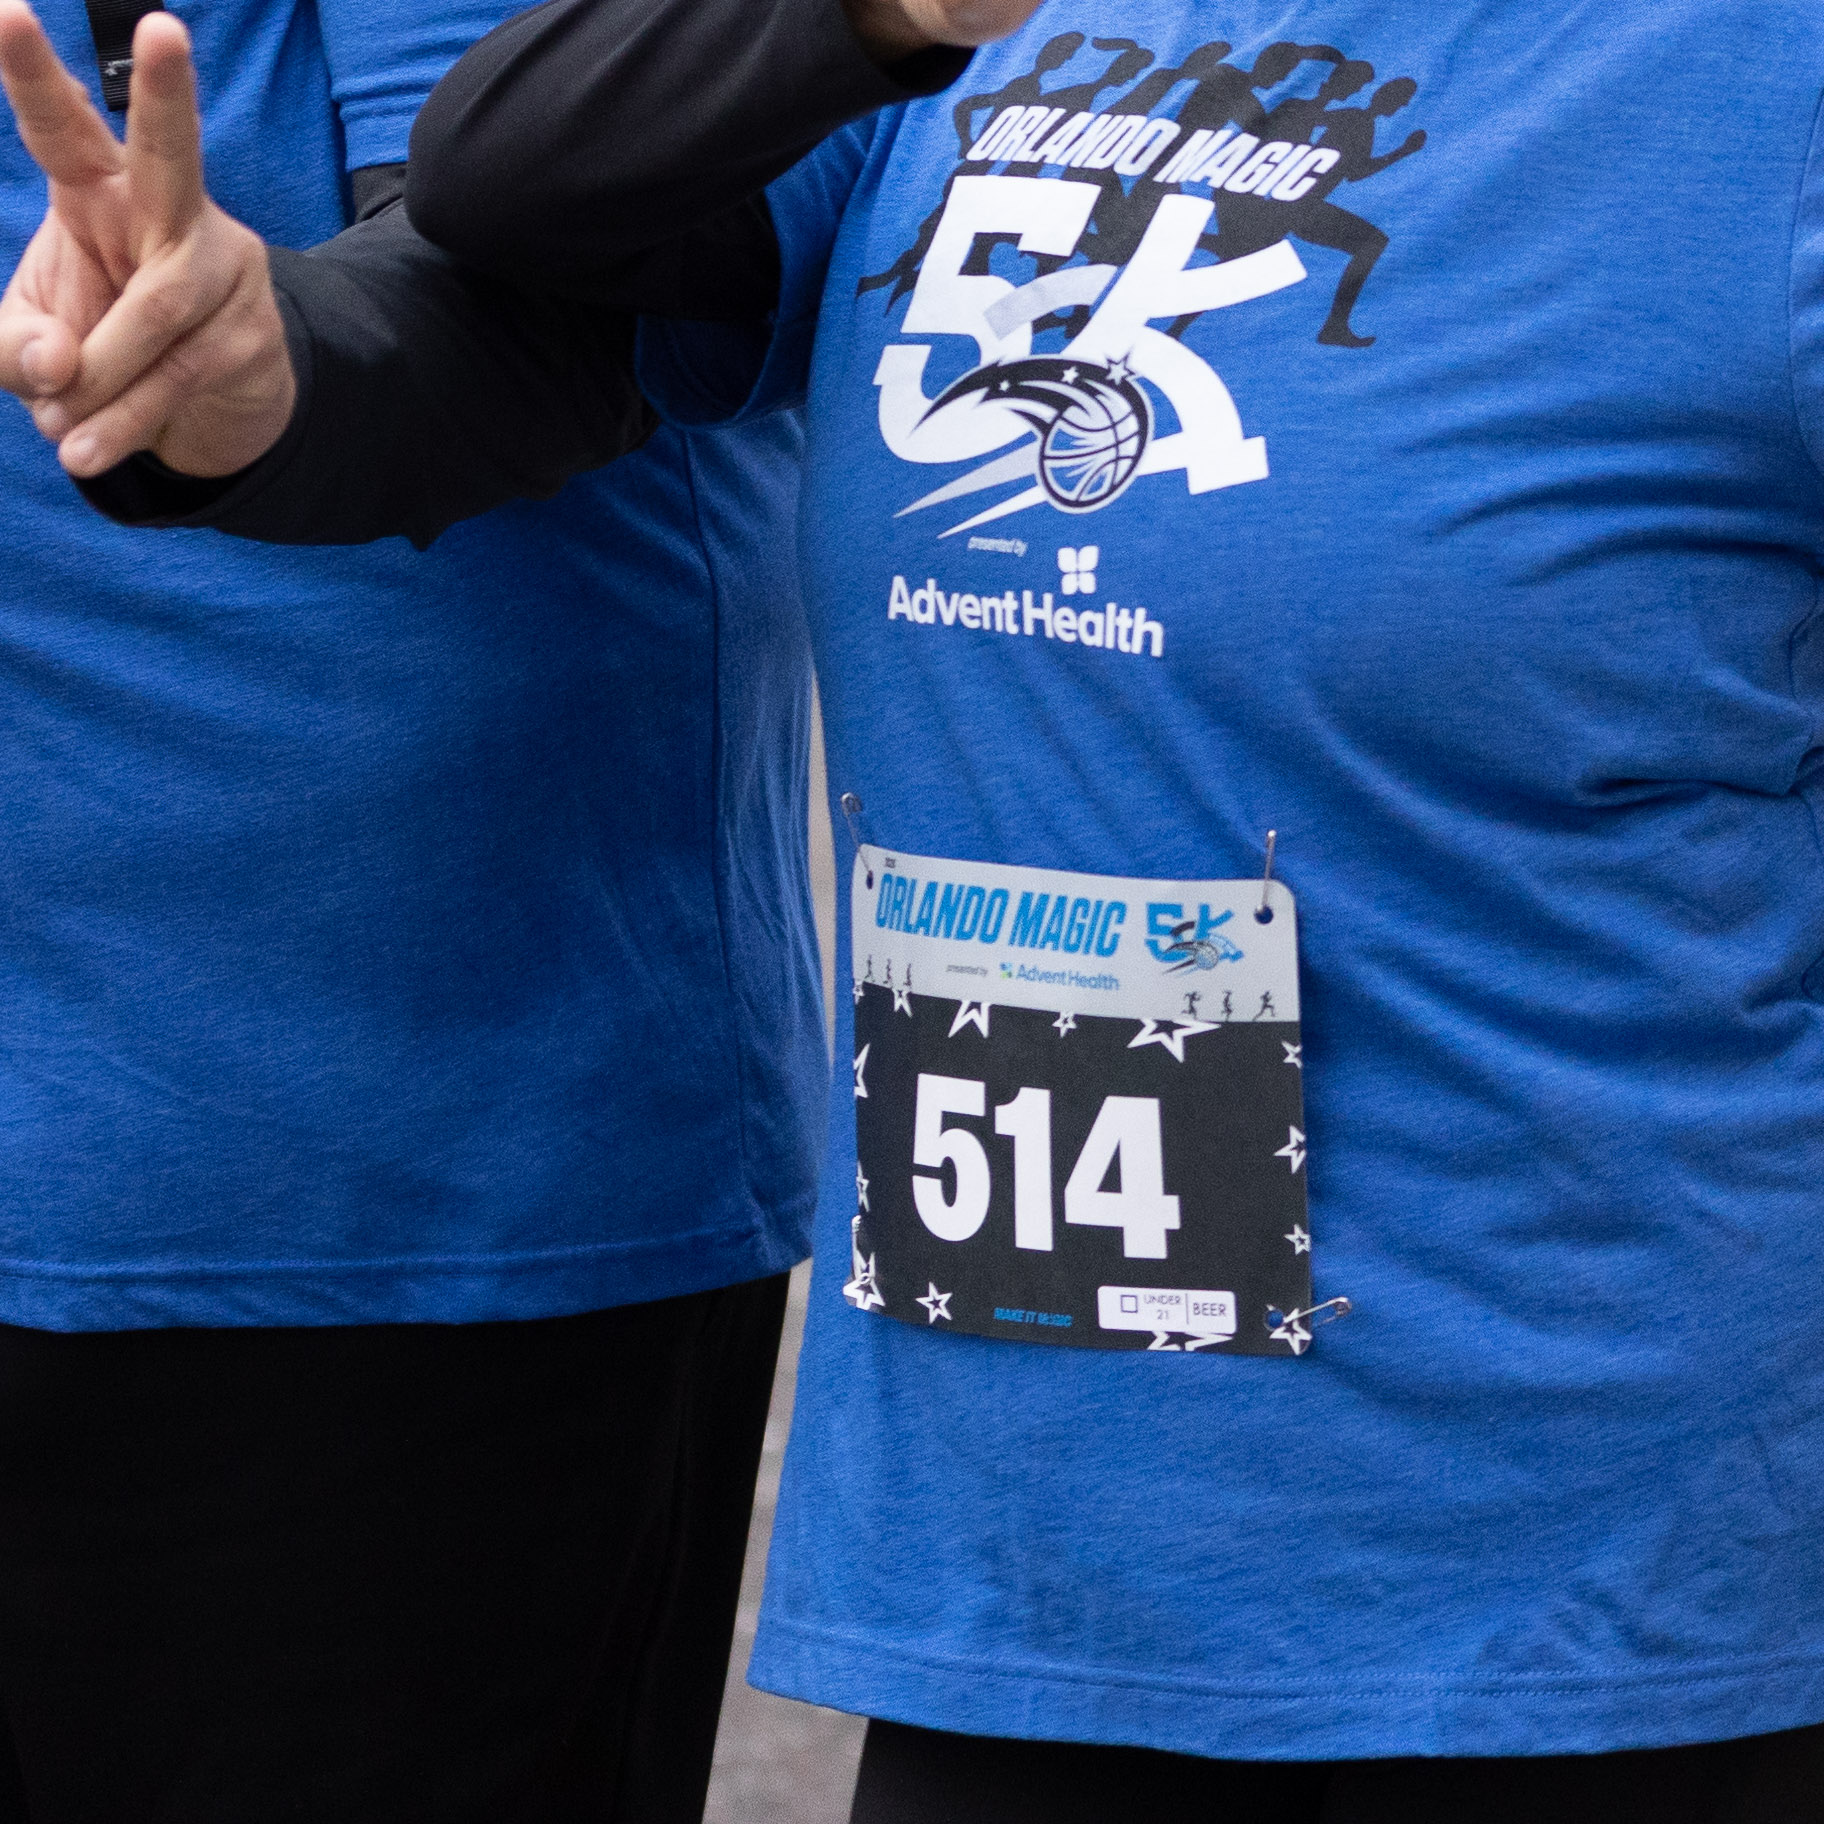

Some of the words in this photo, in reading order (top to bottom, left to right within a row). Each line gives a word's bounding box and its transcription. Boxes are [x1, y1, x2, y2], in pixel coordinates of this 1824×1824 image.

[965, 105, 1182, 177] ORLANDO
[873, 174, 1308, 496] 5K
[888, 575, 1164, 657] AdventHealth
[876, 872, 1010, 944] ORLANDO
[1008, 890, 1127, 958] MAGIC
[1144, 902, 1244, 964] 5K
[1016, 963, 1120, 991] AdventHealth
[911, 1072, 1181, 1260] 514
[1143, 1294, 1182, 1305] UNDER
[1192, 1302, 1227, 1317] BEER
